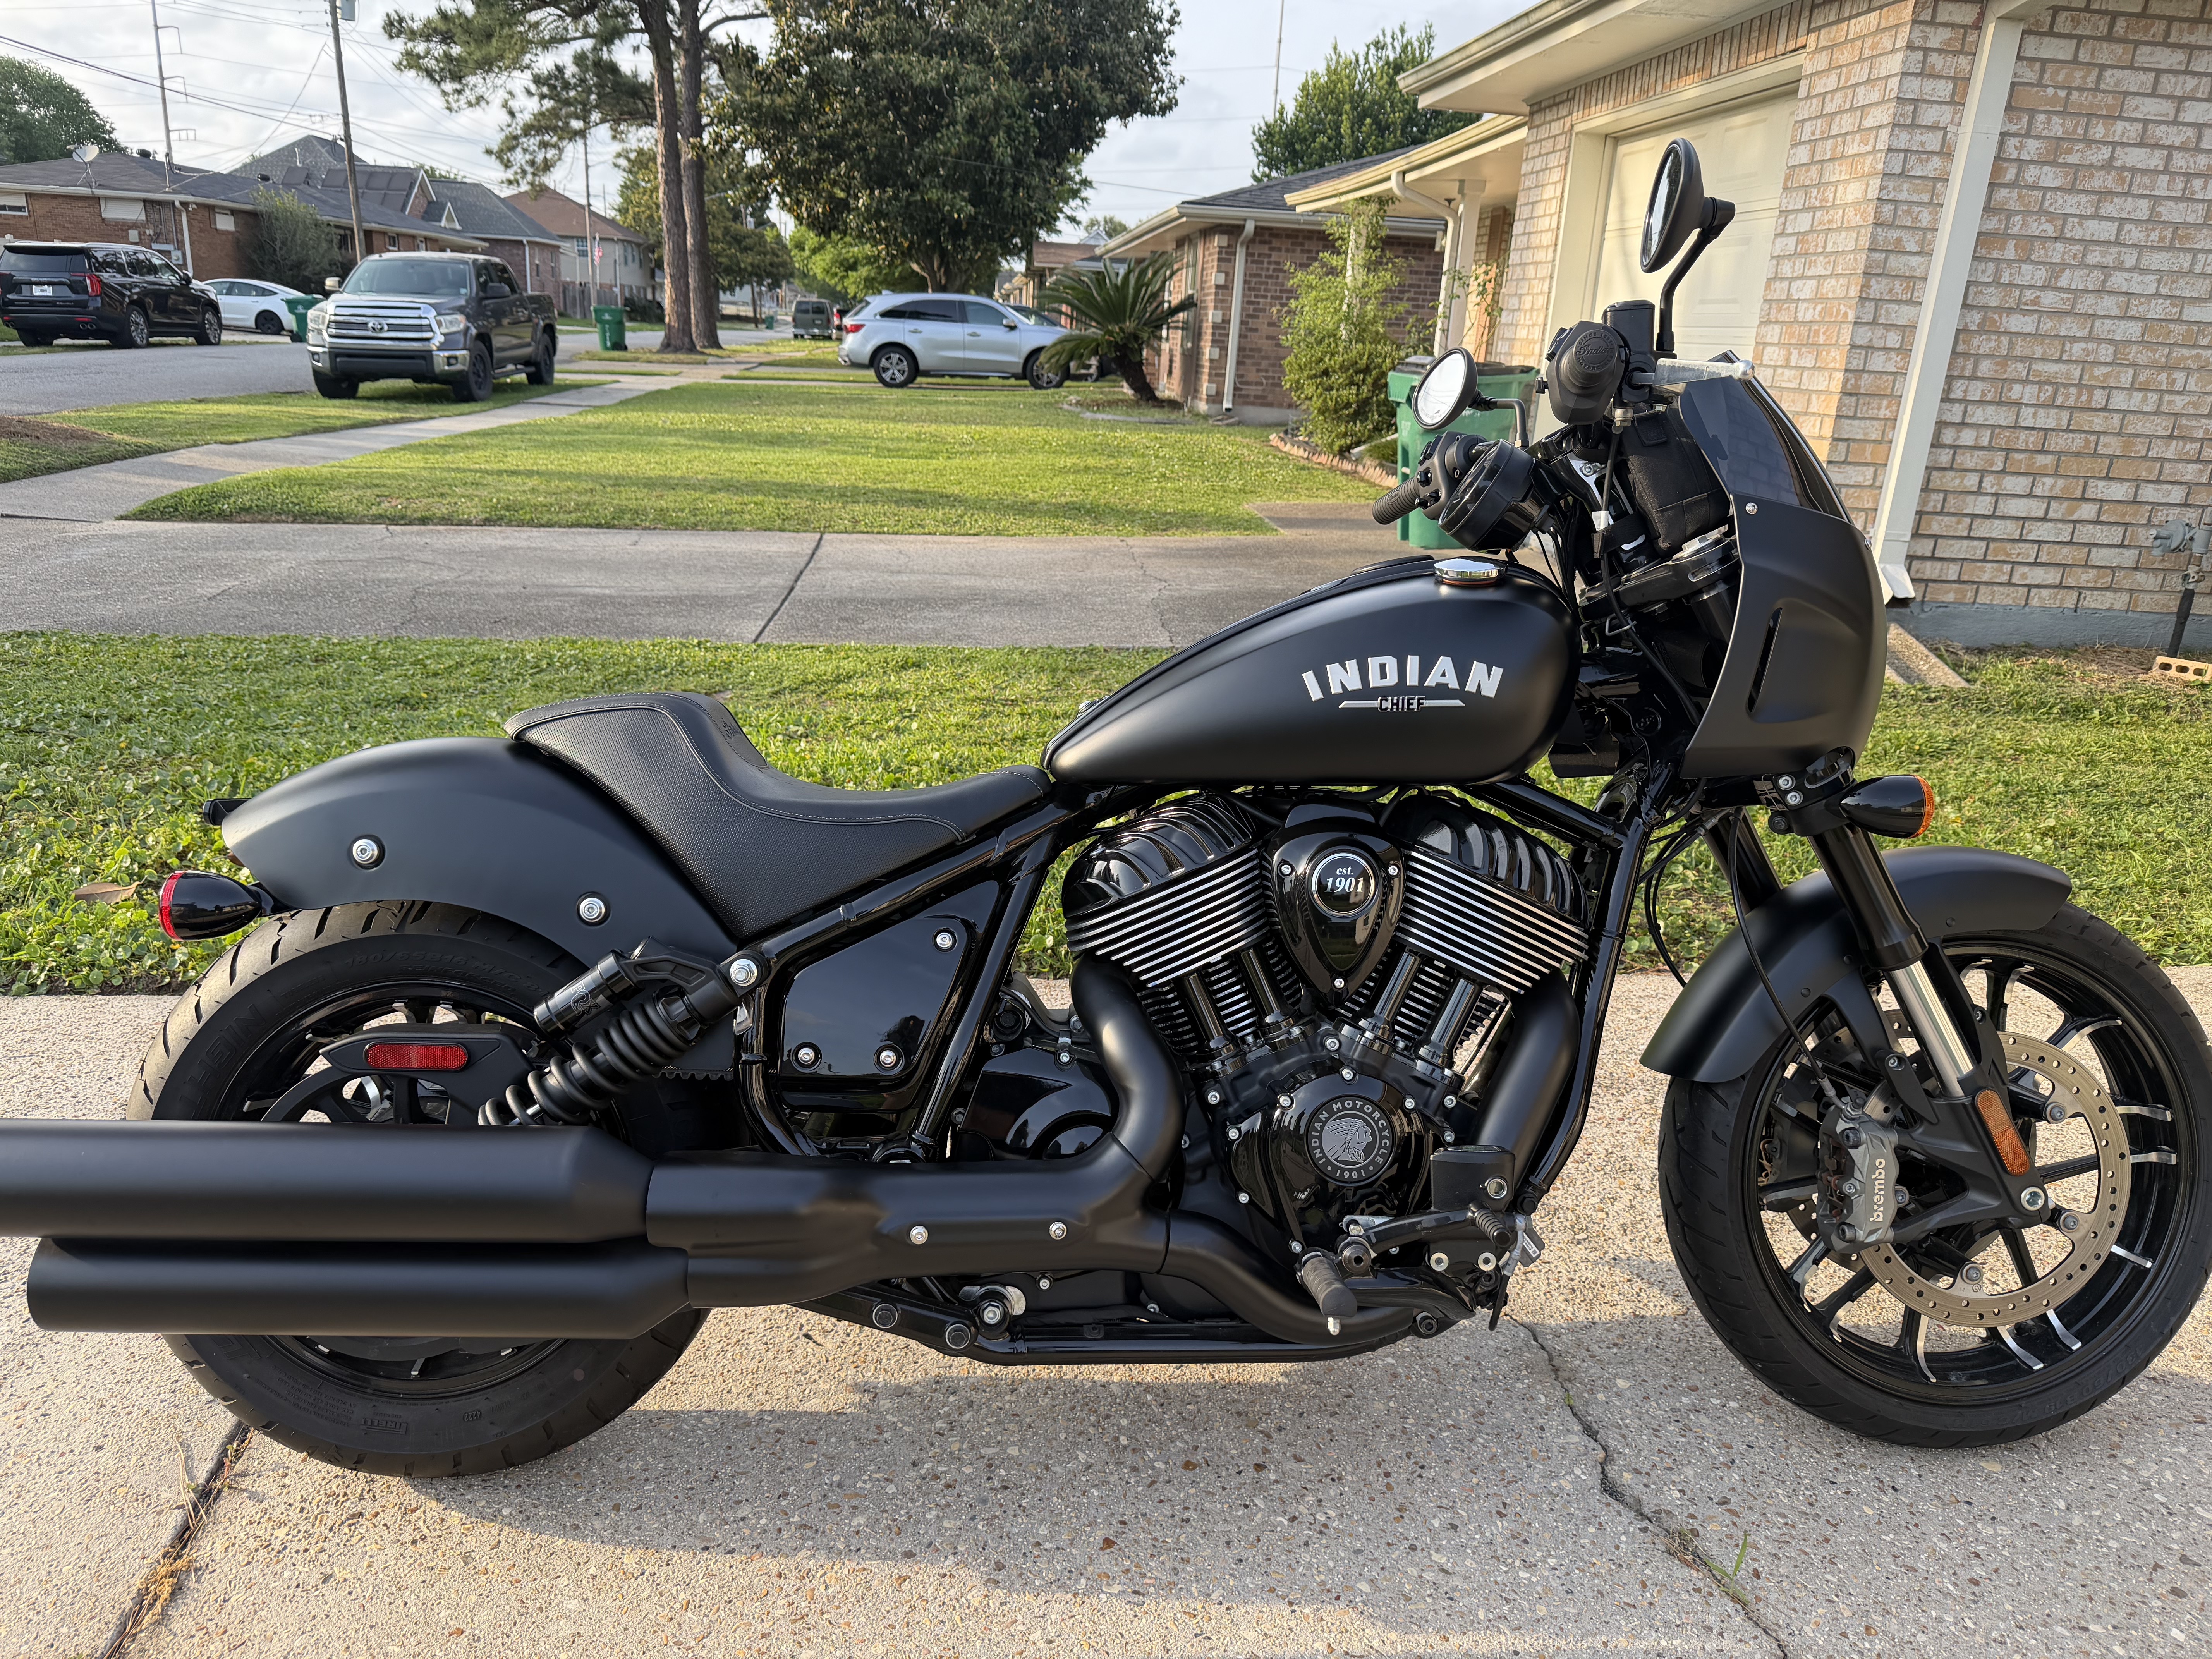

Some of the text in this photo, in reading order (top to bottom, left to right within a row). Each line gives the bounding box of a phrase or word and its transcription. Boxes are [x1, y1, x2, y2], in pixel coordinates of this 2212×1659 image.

[1578, 332, 1597, 346] SINCE
[1302, 655, 1504, 702] INDIAN
[1378, 697, 1426, 712] CHIEF
[1336, 866, 1353, 876] est.
[1324, 877, 1364, 893] 1901
[570, 980, 601, 1016] FOX
[1311, 1100, 1389, 1164] INDIAN MOTORCYCLE
[1336, 1169, 1365, 1179] 1901
[1869, 1158, 1886, 1222] brembo
[464, 1411, 481, 1422] 4222
[360, 1417, 408, 1436] PIRELLI
